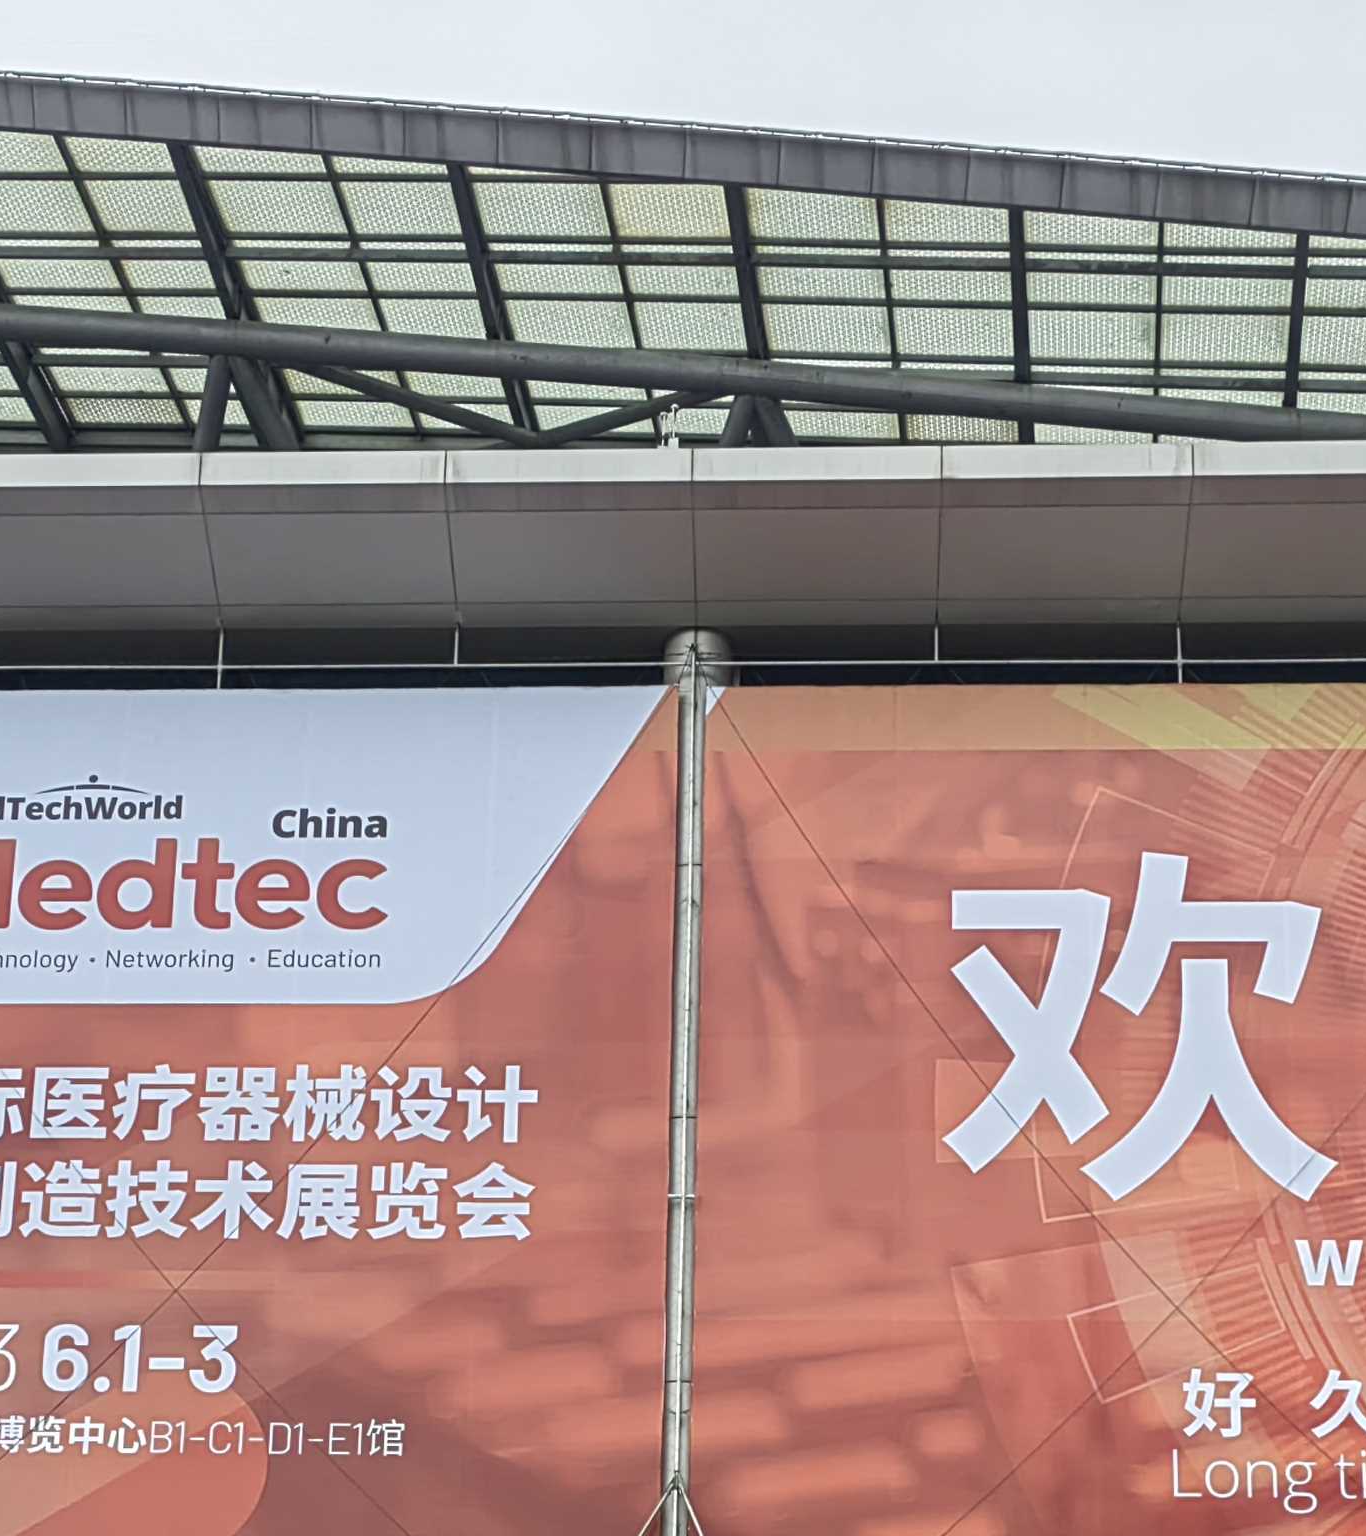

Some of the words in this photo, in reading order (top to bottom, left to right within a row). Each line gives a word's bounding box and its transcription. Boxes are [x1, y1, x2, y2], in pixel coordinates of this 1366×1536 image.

[271, 809, 388, 840] China
[105, 948, 234, 973] Networking
[267, 948, 382, 970] Education
[41, 1322, 239, 1393] 6.1-3
[1171, 1447, 1318, 1514] Long
